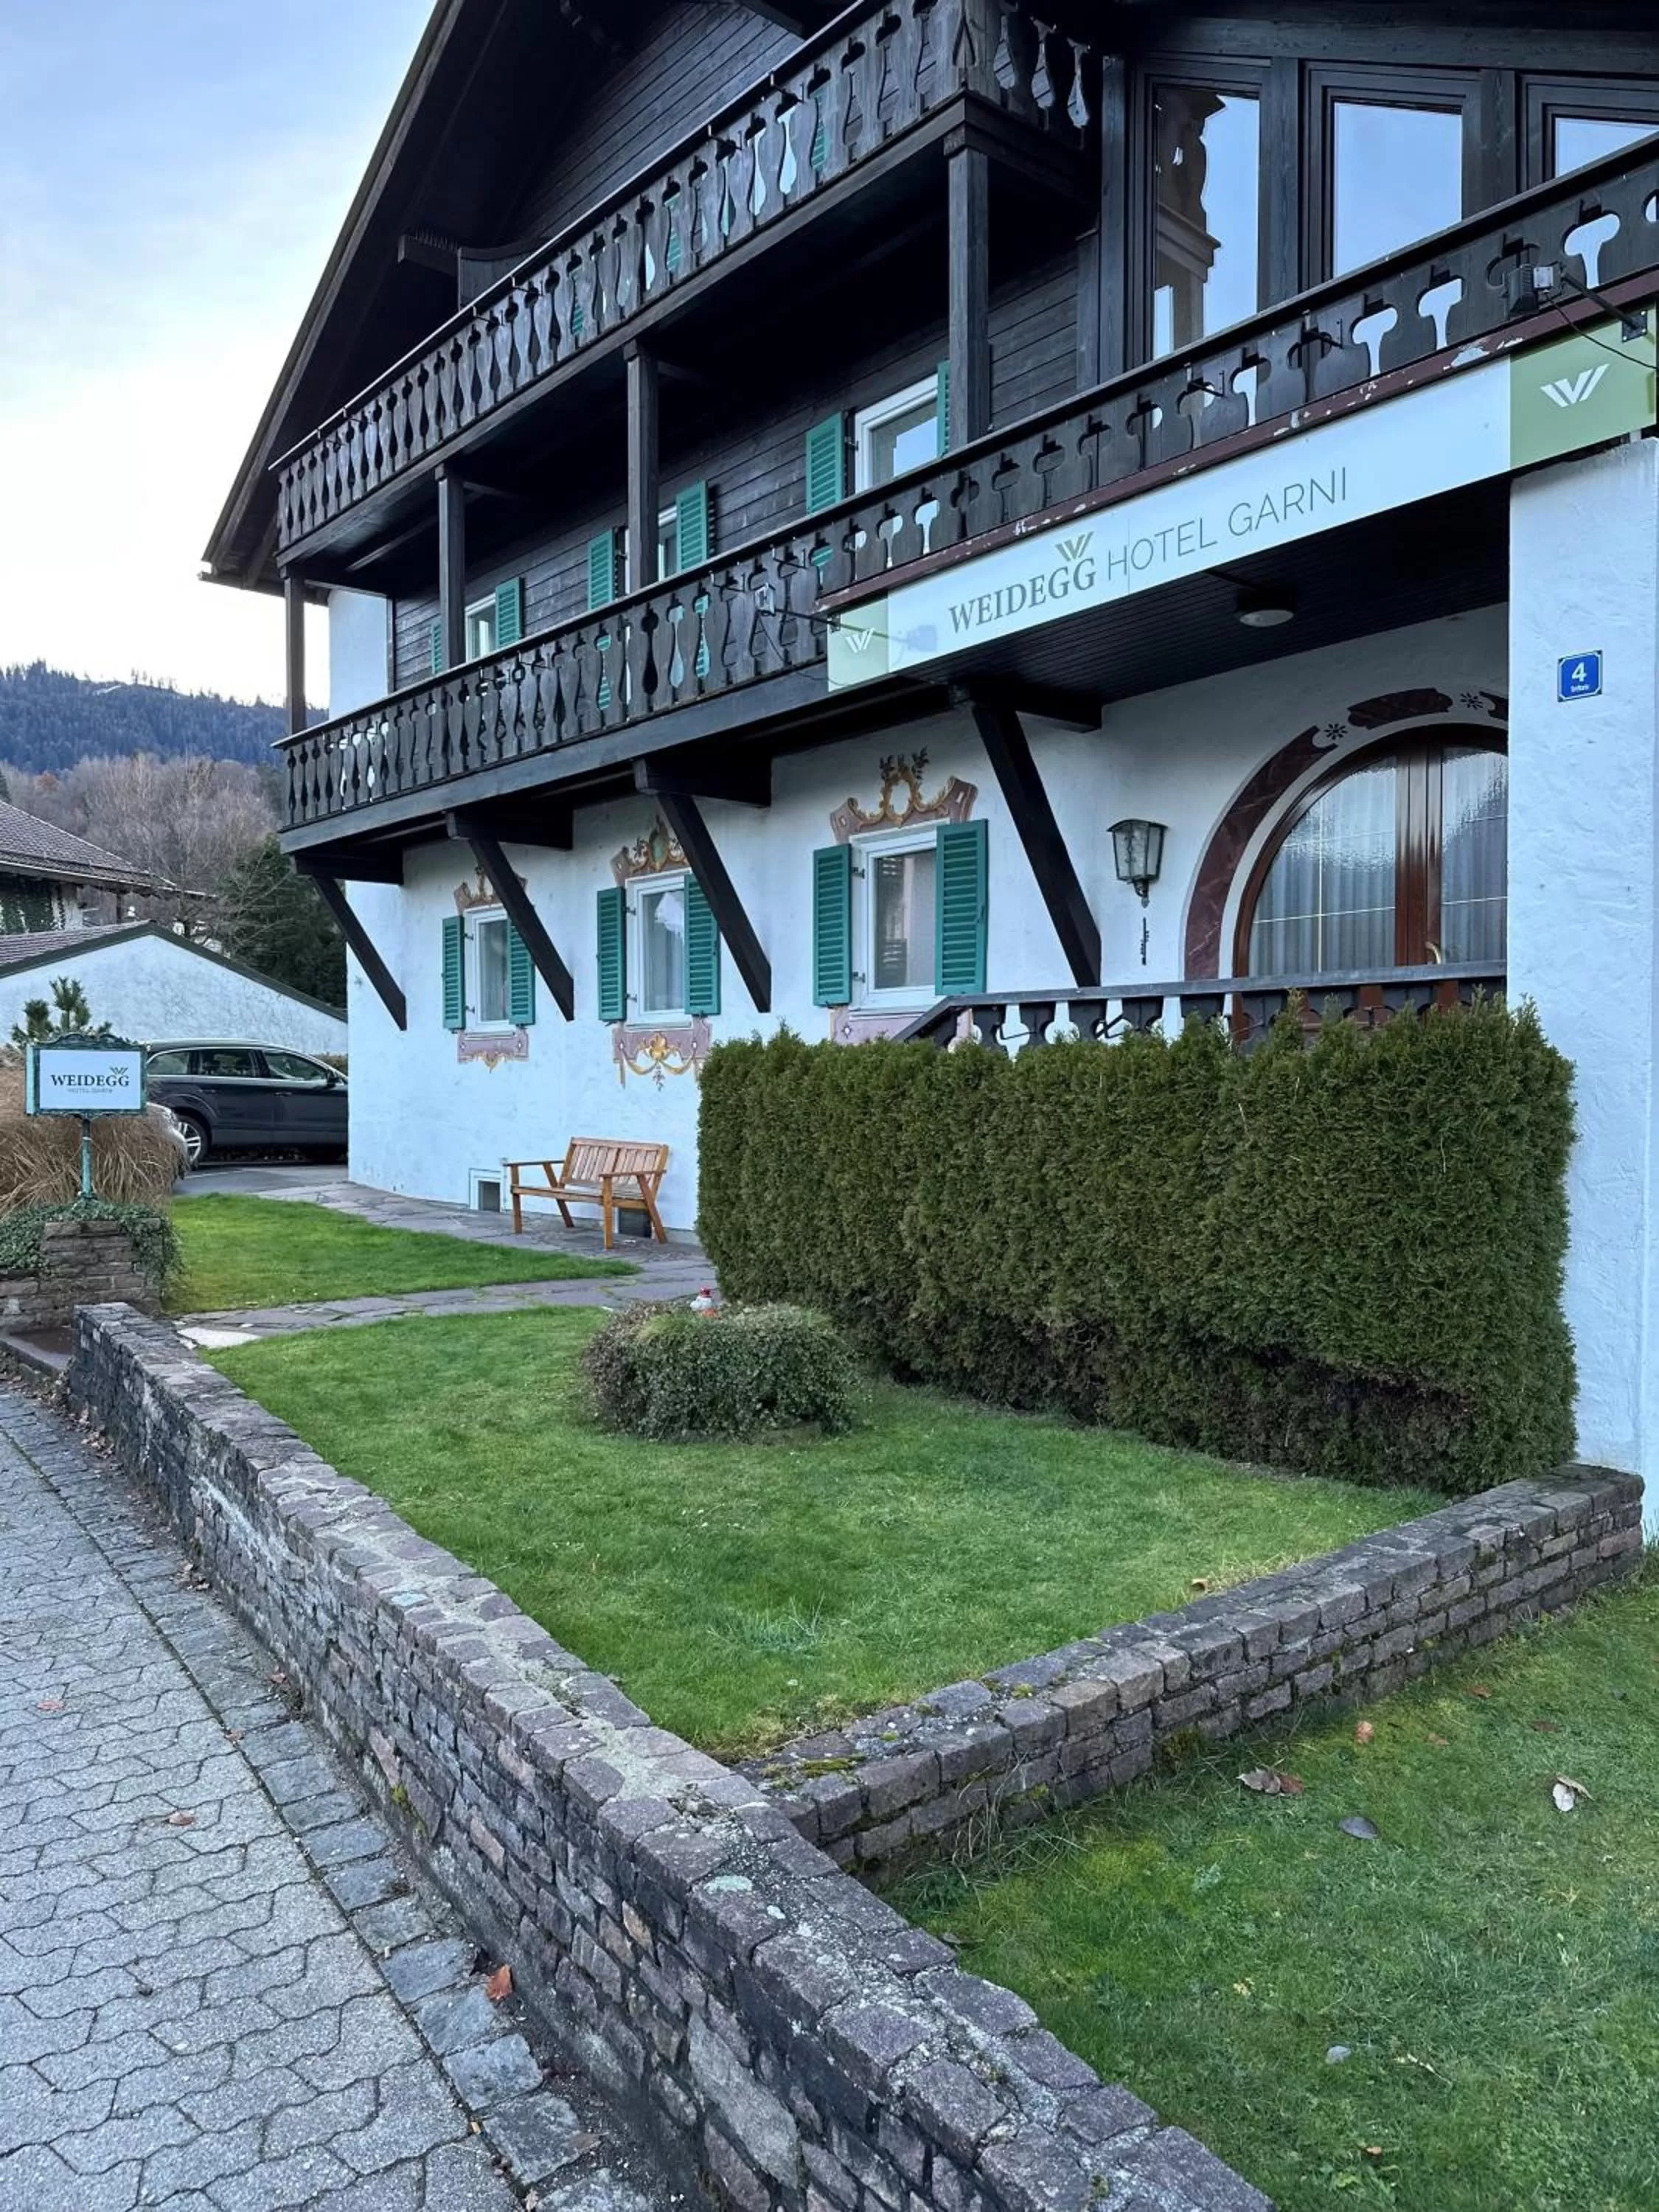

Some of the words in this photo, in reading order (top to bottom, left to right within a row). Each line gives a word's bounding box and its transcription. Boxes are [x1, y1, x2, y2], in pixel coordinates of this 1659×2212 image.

[948, 557, 1098, 633] WEIDEGG
[1108, 517, 1219, 580] HOTEL
[1228, 467, 1346, 536] GARNI
[1571, 662, 1587, 682] 4
[50, 1074, 129, 1087] WEIDEGG
